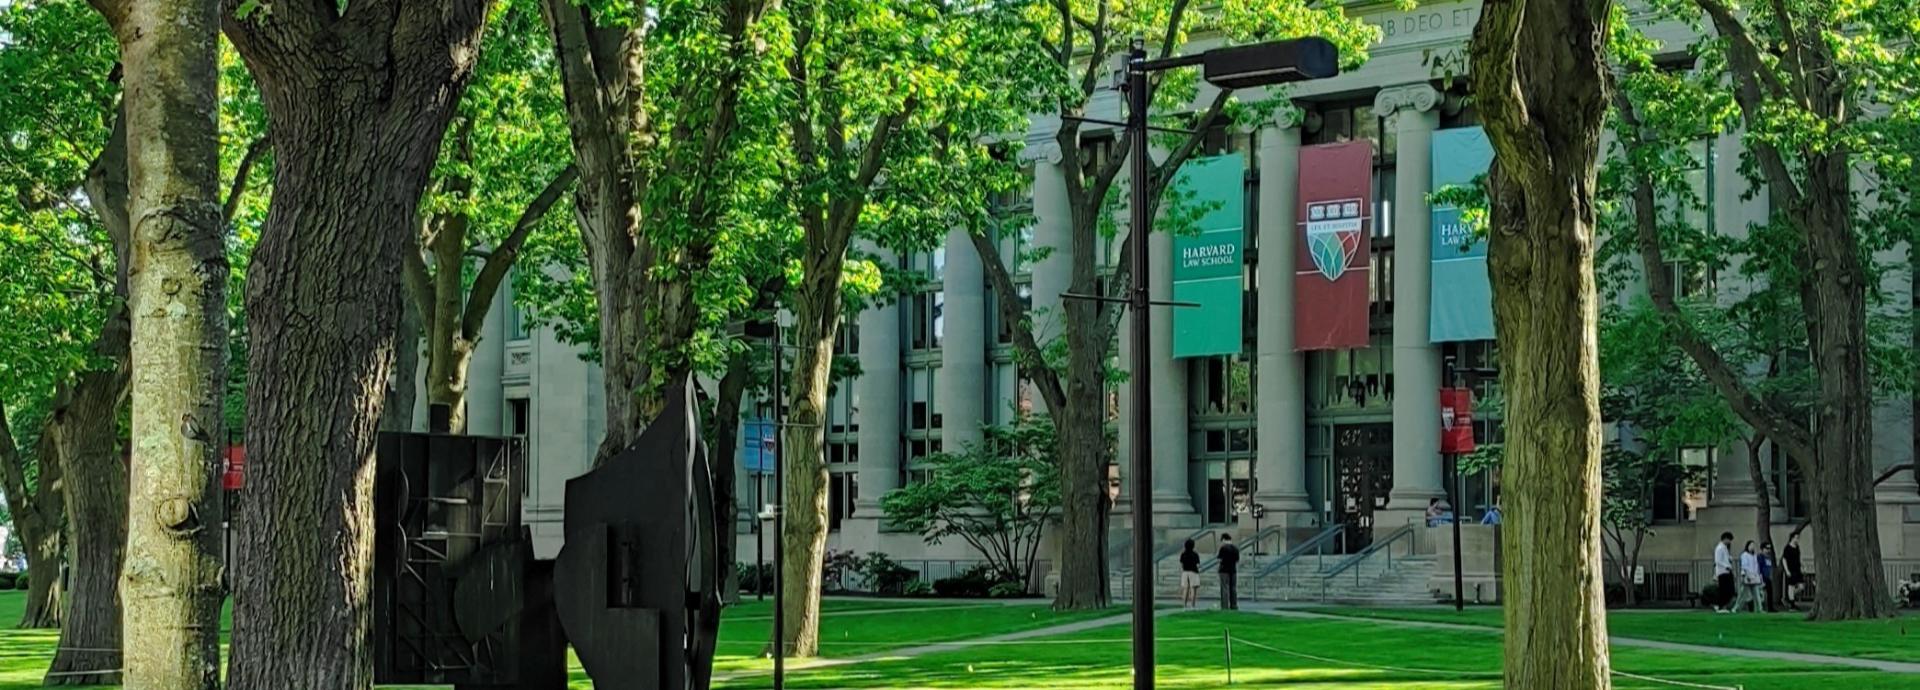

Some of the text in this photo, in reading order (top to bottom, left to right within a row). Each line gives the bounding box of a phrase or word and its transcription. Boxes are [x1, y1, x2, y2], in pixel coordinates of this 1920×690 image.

[1404, 12, 1443, 34] DEO
[1452, 7, 1473, 27] ET
[1441, 222, 1475, 236] HARV
[1441, 236, 1459, 246] LAW
[1183, 243, 1235, 259] HARVARD
[1183, 255, 1234, 268] LAW SCHOOL
